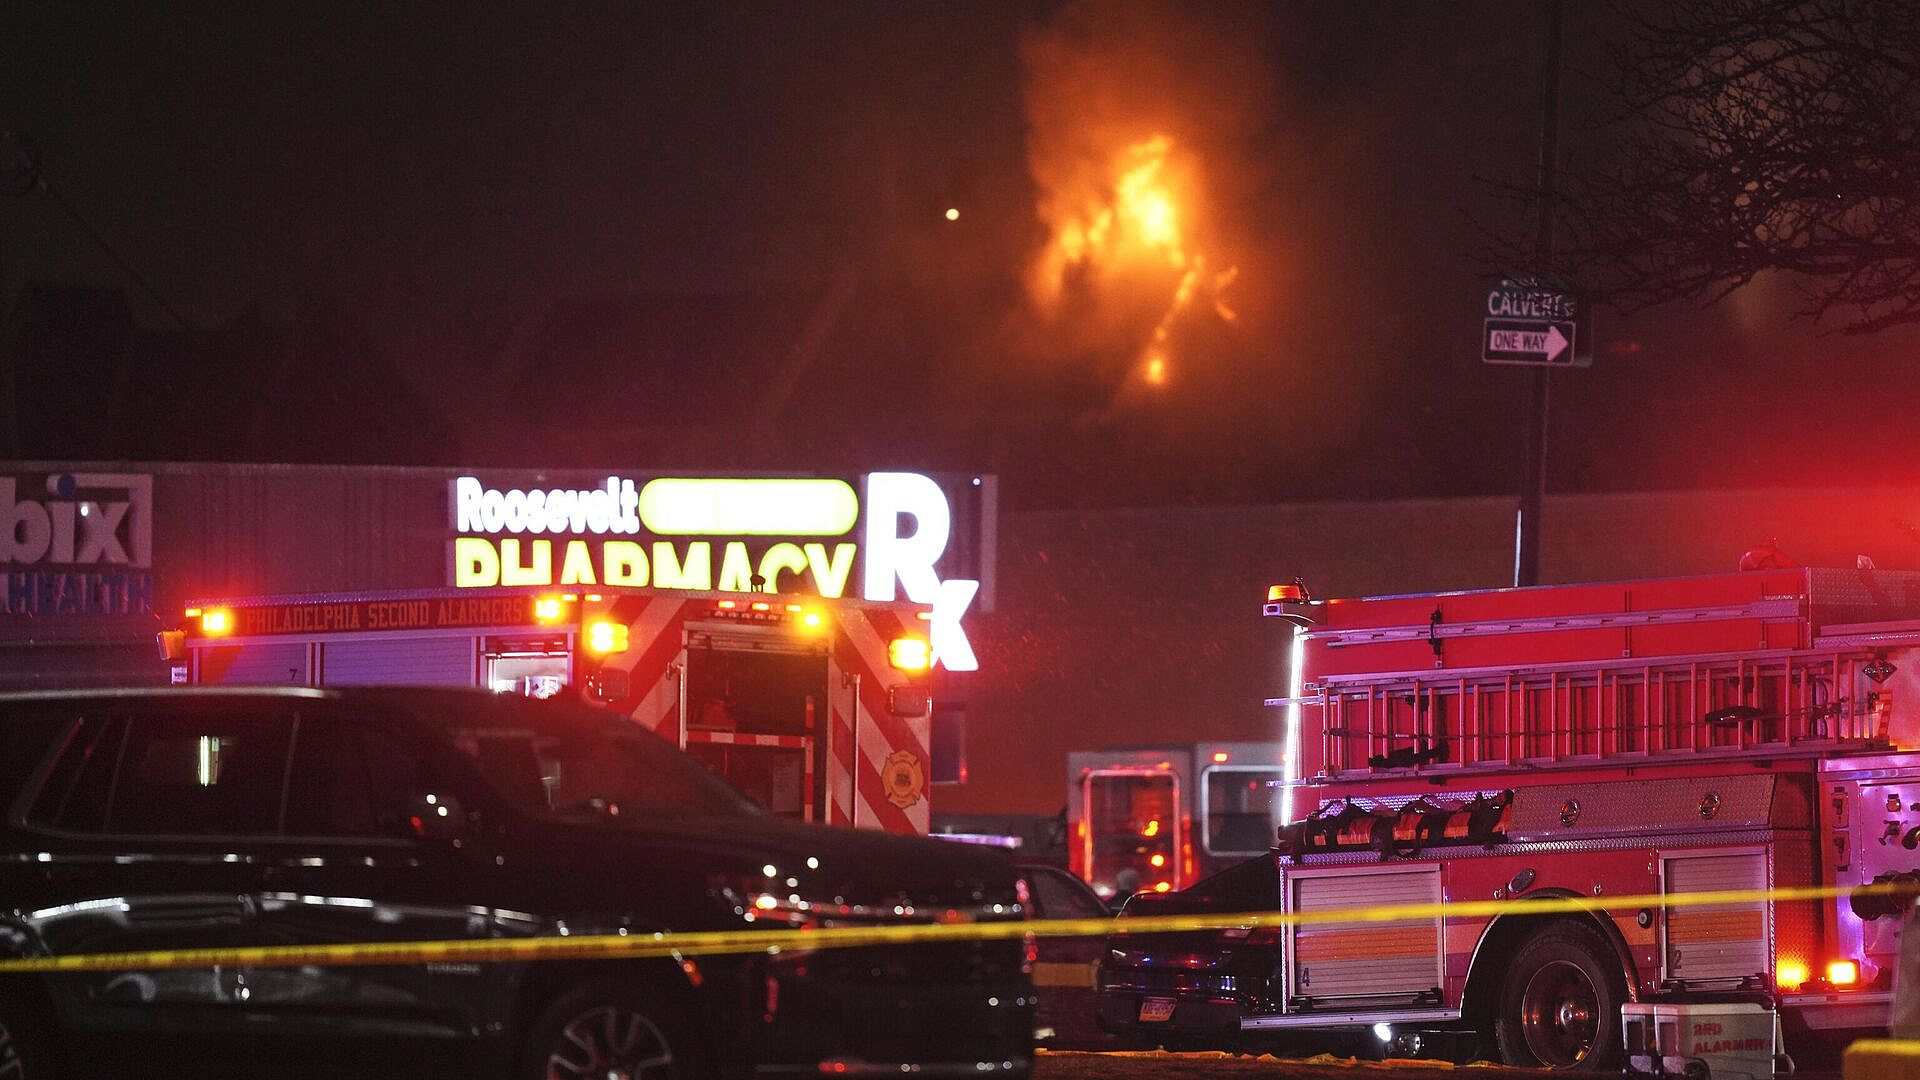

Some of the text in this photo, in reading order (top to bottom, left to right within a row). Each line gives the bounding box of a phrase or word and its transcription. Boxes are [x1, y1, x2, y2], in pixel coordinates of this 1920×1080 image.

[1495, 332, 1547, 350] ONE WAY
[456, 477, 640, 533] Roosevelt
[248, 598, 522, 633] PHILADELPHIA SECOND ALARMERS
[289, 668, 298, 680] 7
